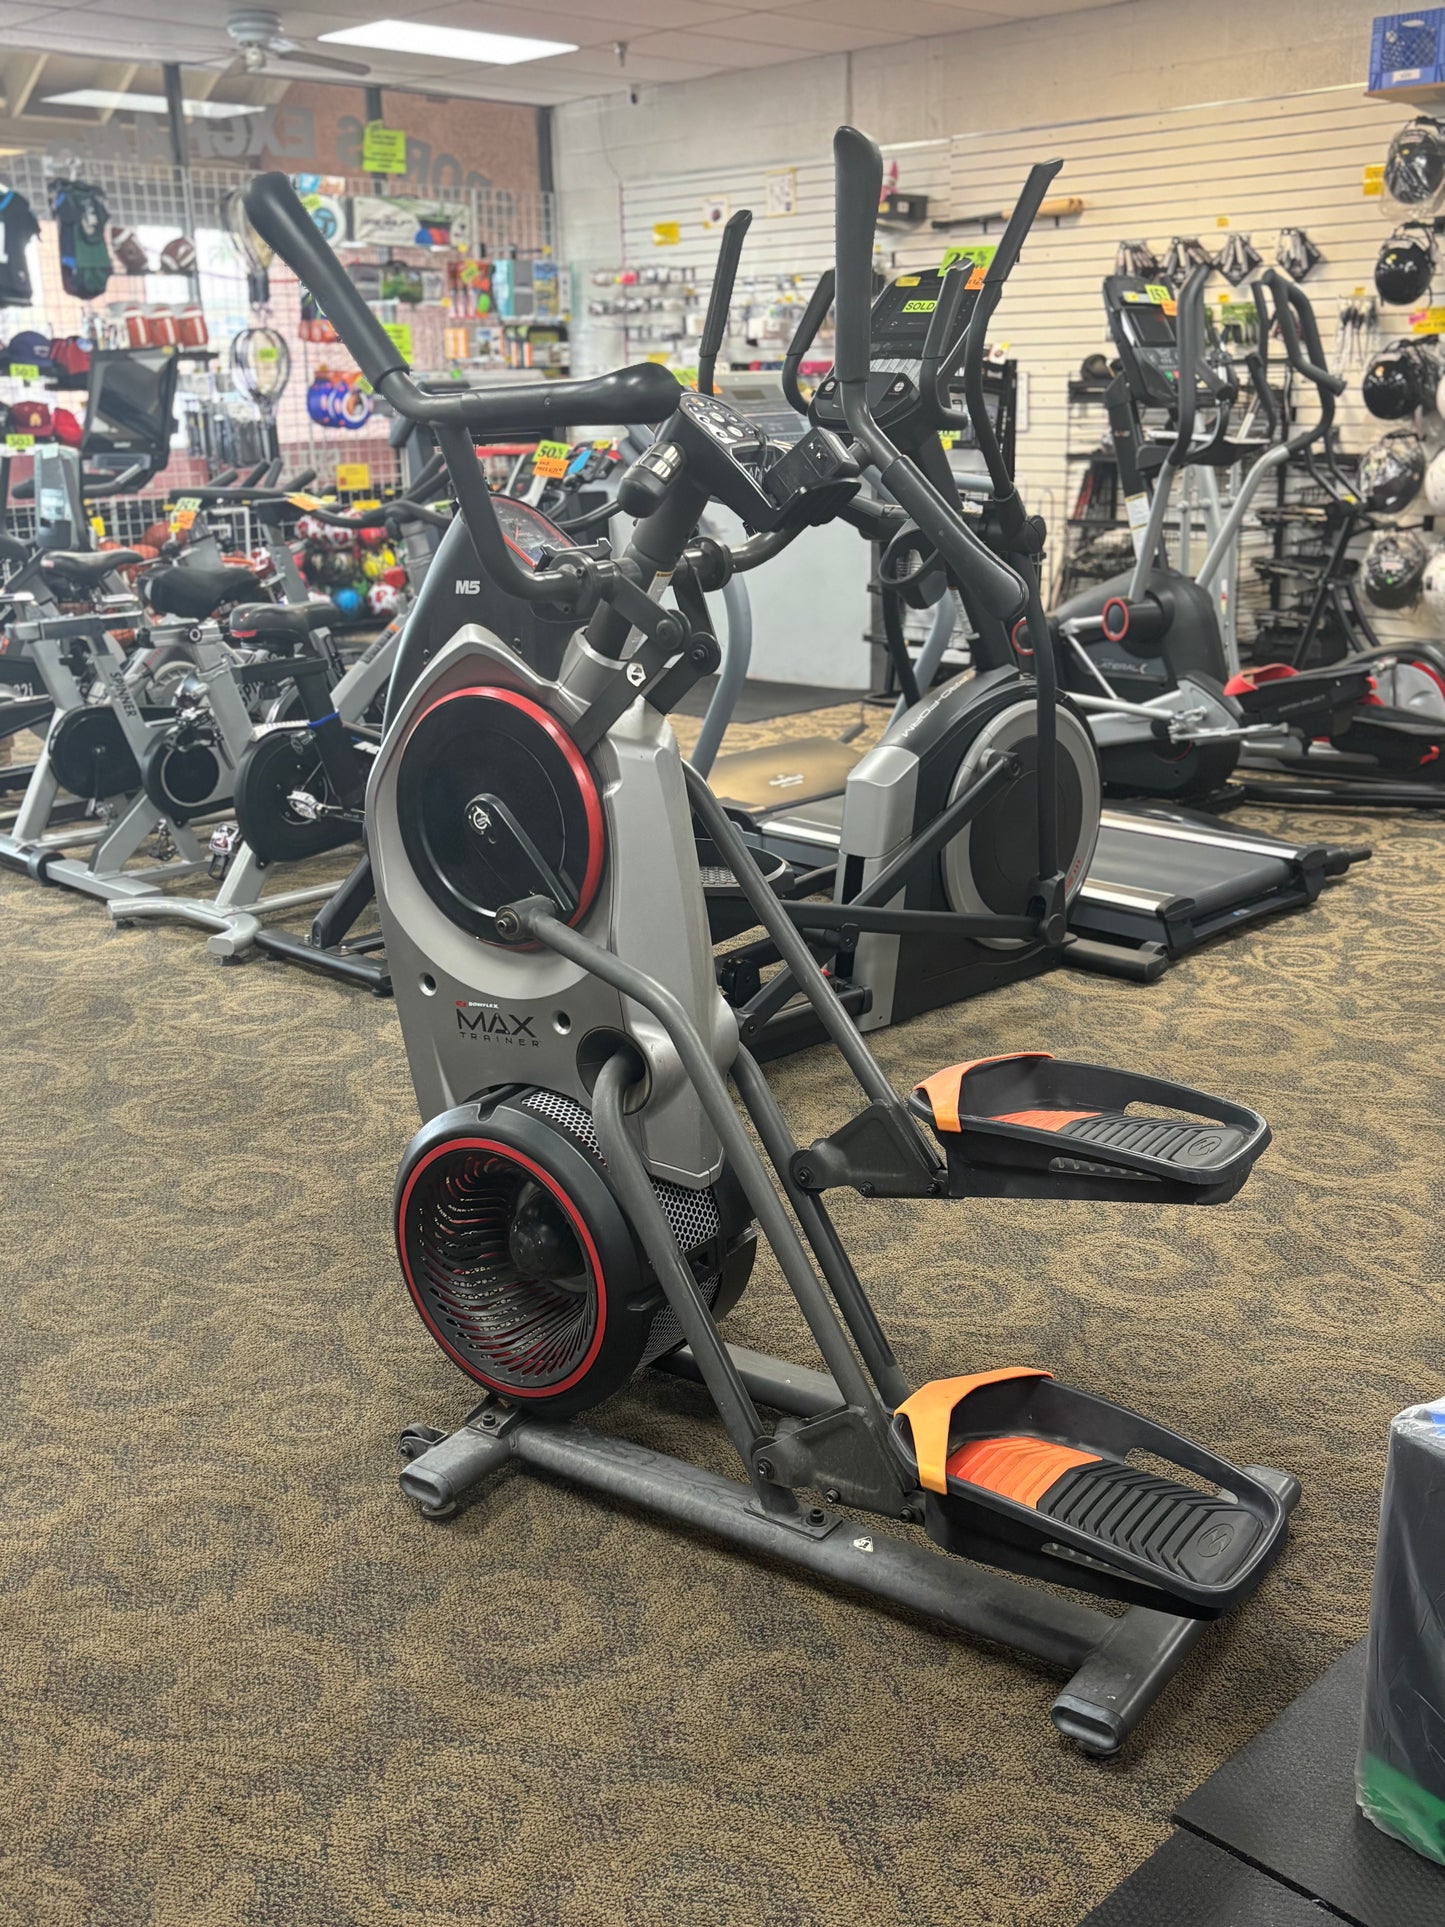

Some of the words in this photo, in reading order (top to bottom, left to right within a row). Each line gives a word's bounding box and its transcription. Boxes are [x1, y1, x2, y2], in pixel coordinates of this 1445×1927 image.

[905, 301, 936, 311] SOLD
[455, 579, 481, 595] M5
[109, 672, 138, 717] SPINNER
[901, 675, 969, 738] PRO-FORM
[468, 1001, 499, 1009] BOWFLEX
[456, 1008, 537, 1038] MAX
[458, 1031, 541, 1047] TRAINER
